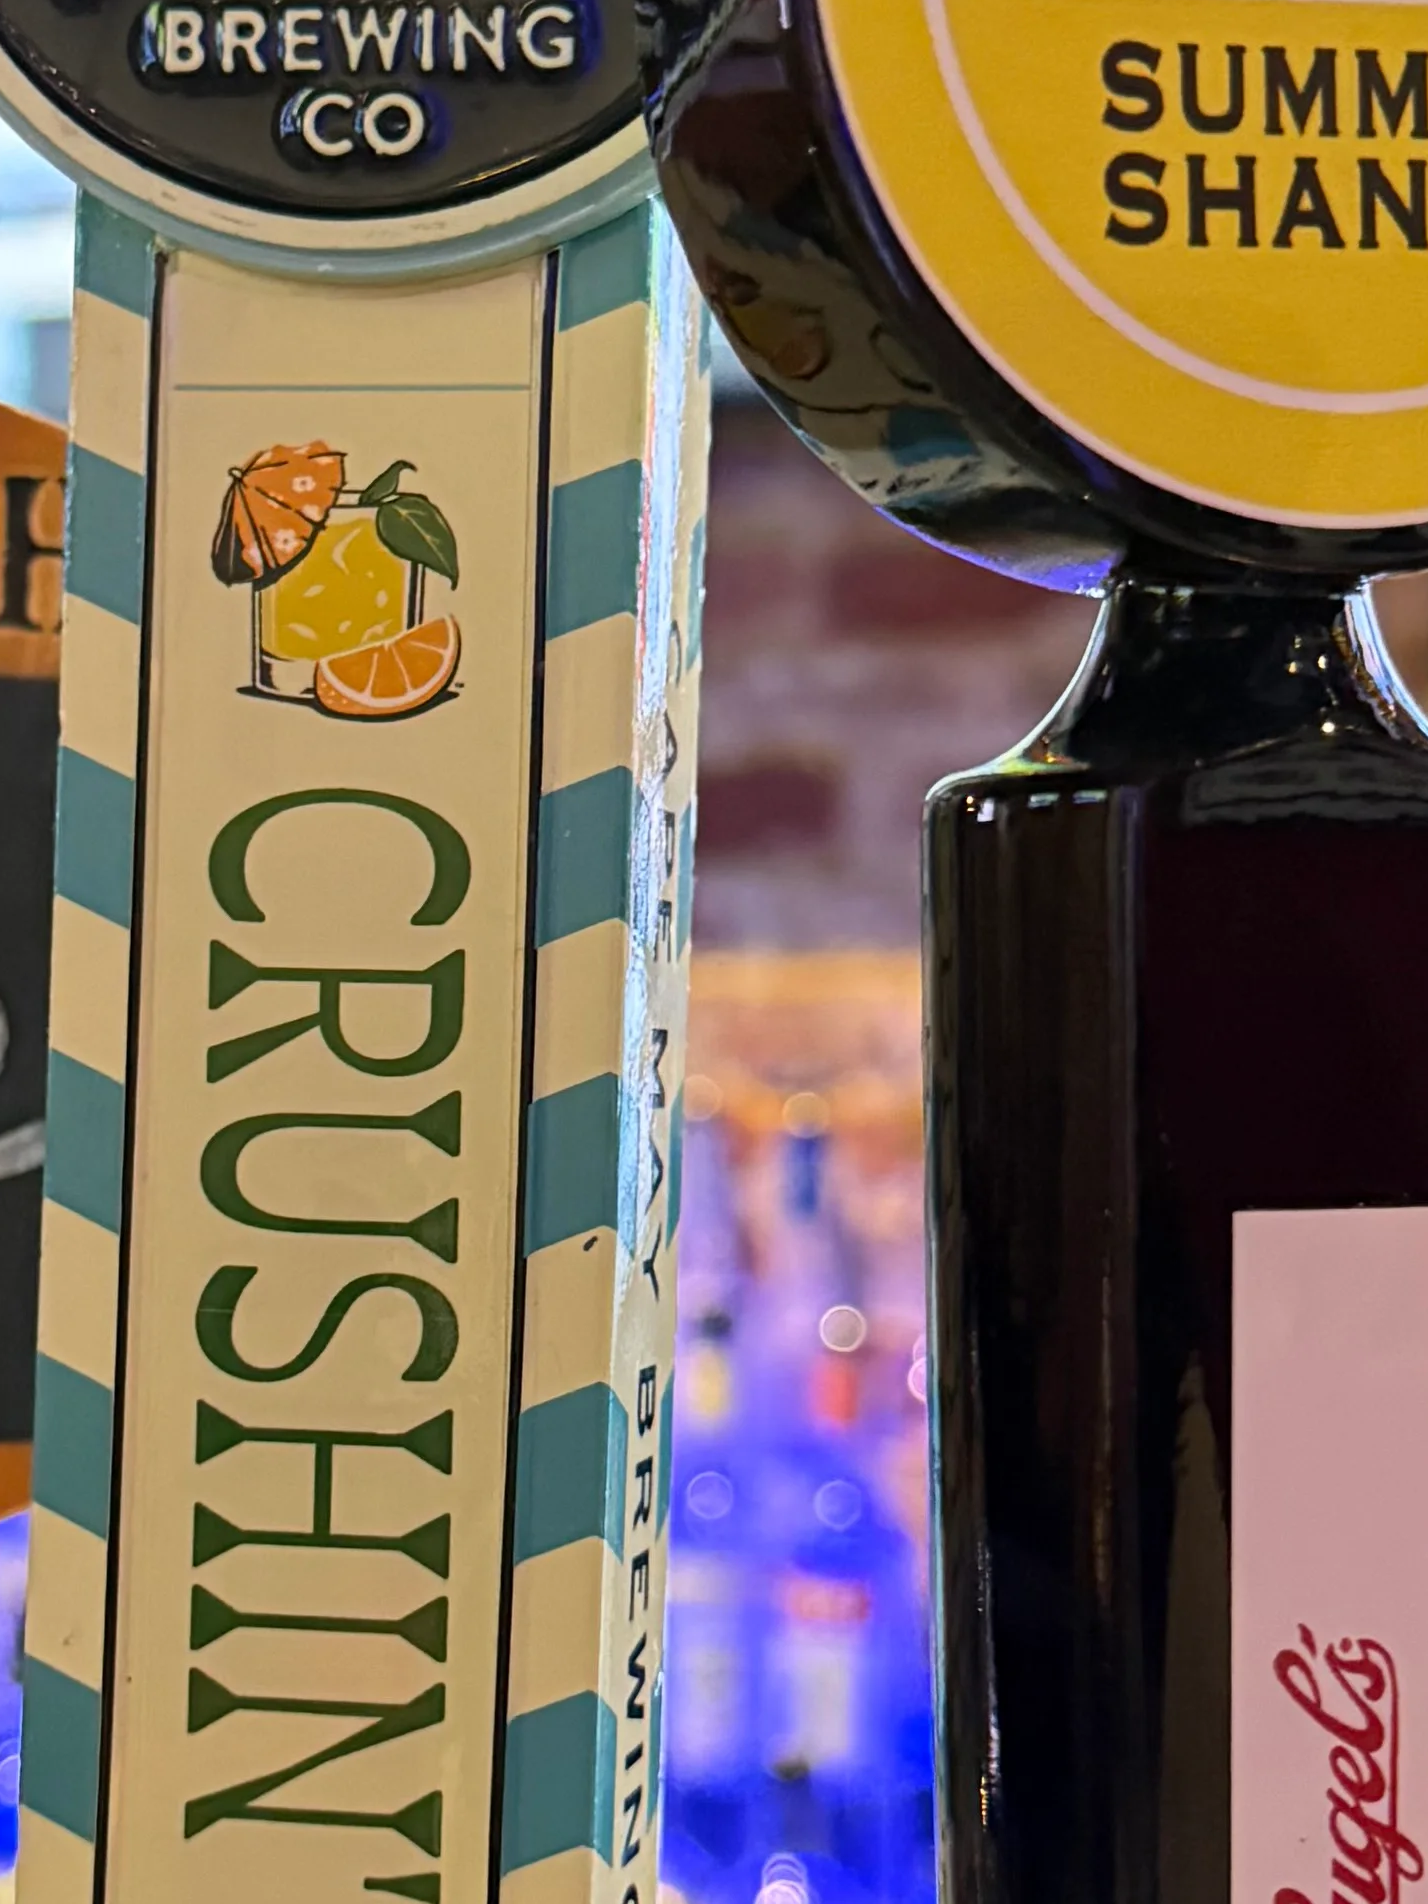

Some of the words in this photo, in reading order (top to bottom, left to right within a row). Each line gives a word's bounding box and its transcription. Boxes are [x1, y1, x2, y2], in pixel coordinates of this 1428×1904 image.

[160, 3, 578, 76] BREWING
[297, 90, 427, 158] CO
[642, 1027, 669, 1304] MAY
